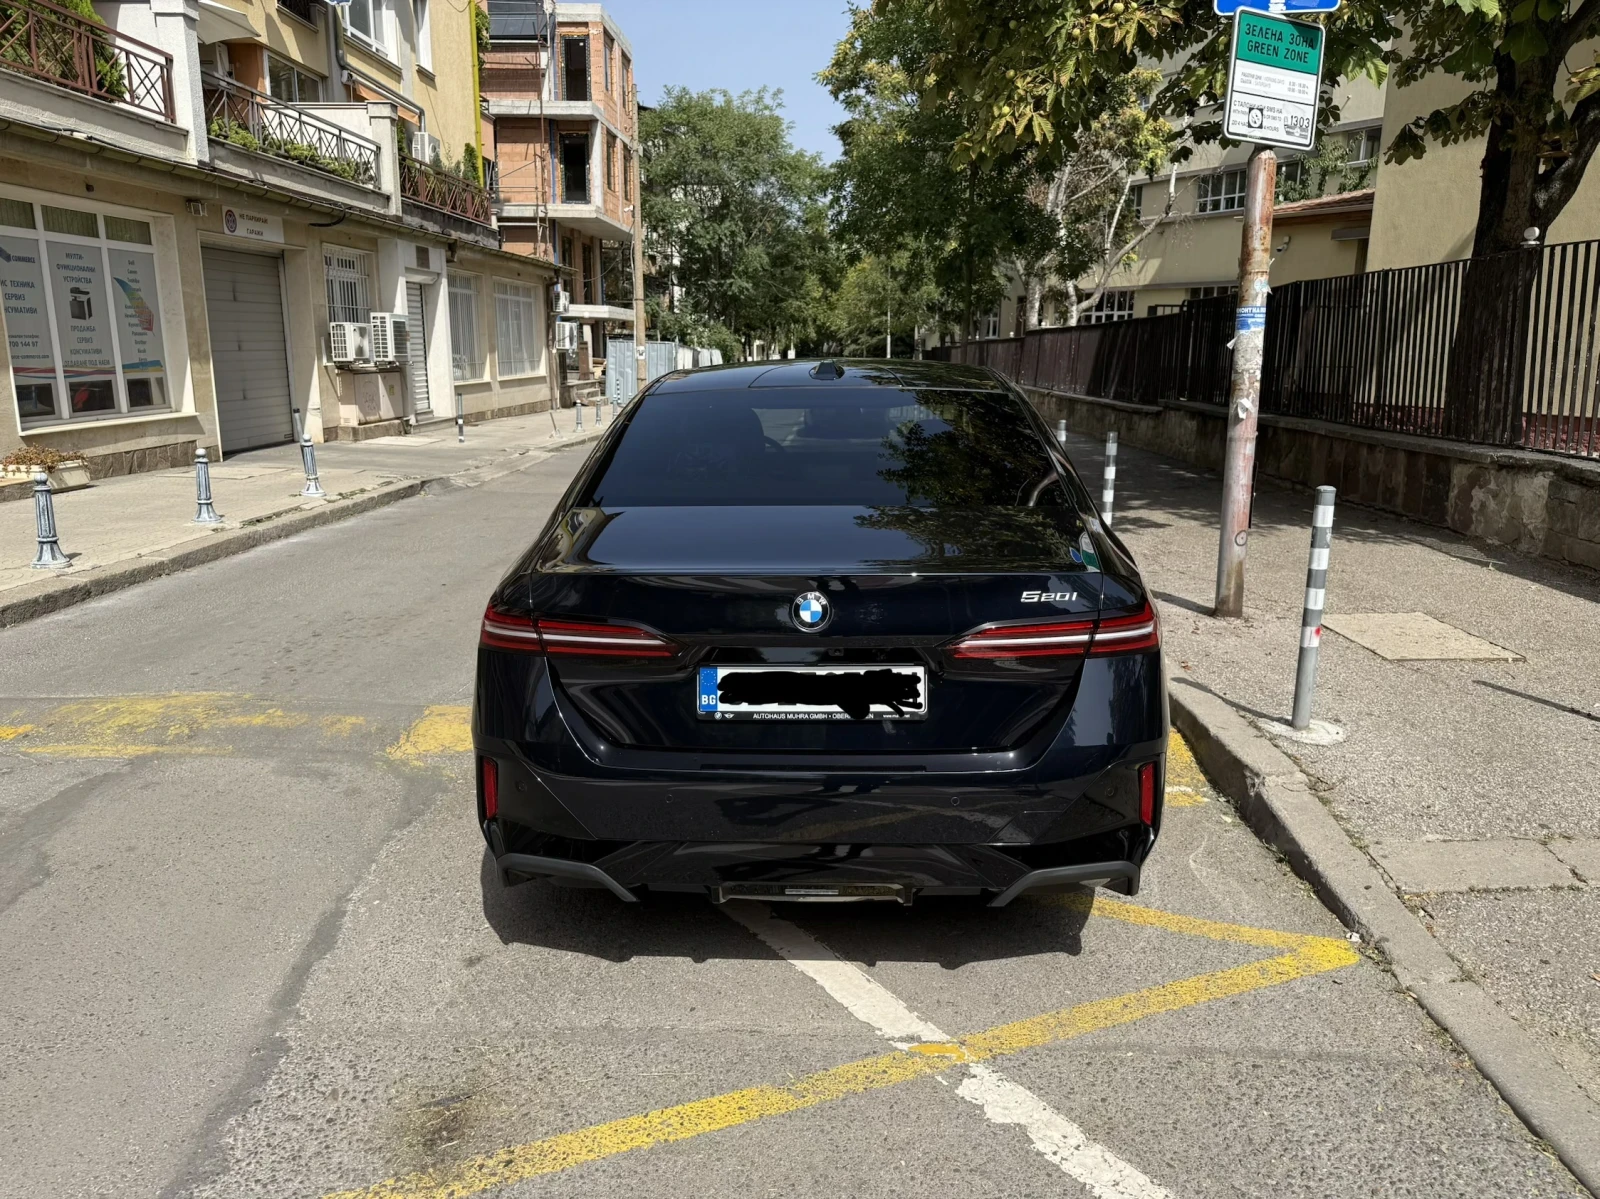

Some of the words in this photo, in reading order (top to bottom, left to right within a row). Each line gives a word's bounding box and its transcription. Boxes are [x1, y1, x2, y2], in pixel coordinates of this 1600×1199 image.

[1244, 23, 1283, 43] ЗЕЛЕНА
[1288, 33, 1315, 49] ЗОНА
[1247, 40, 1280, 58] GREEN
[1283, 47, 1309, 64] ZONE
[1290, 114, 1310, 129] 1303
[246, 228, 264, 236] ГАРАЖИ
[11, 254, 36, 264] COMMERCE
[10, 280, 36, 289] ТЕХНИКА
[4, 292, 26, 301] СЕРВИЗ
[796, 593, 827, 605] BMW
[701, 694, 716, 705] BG
